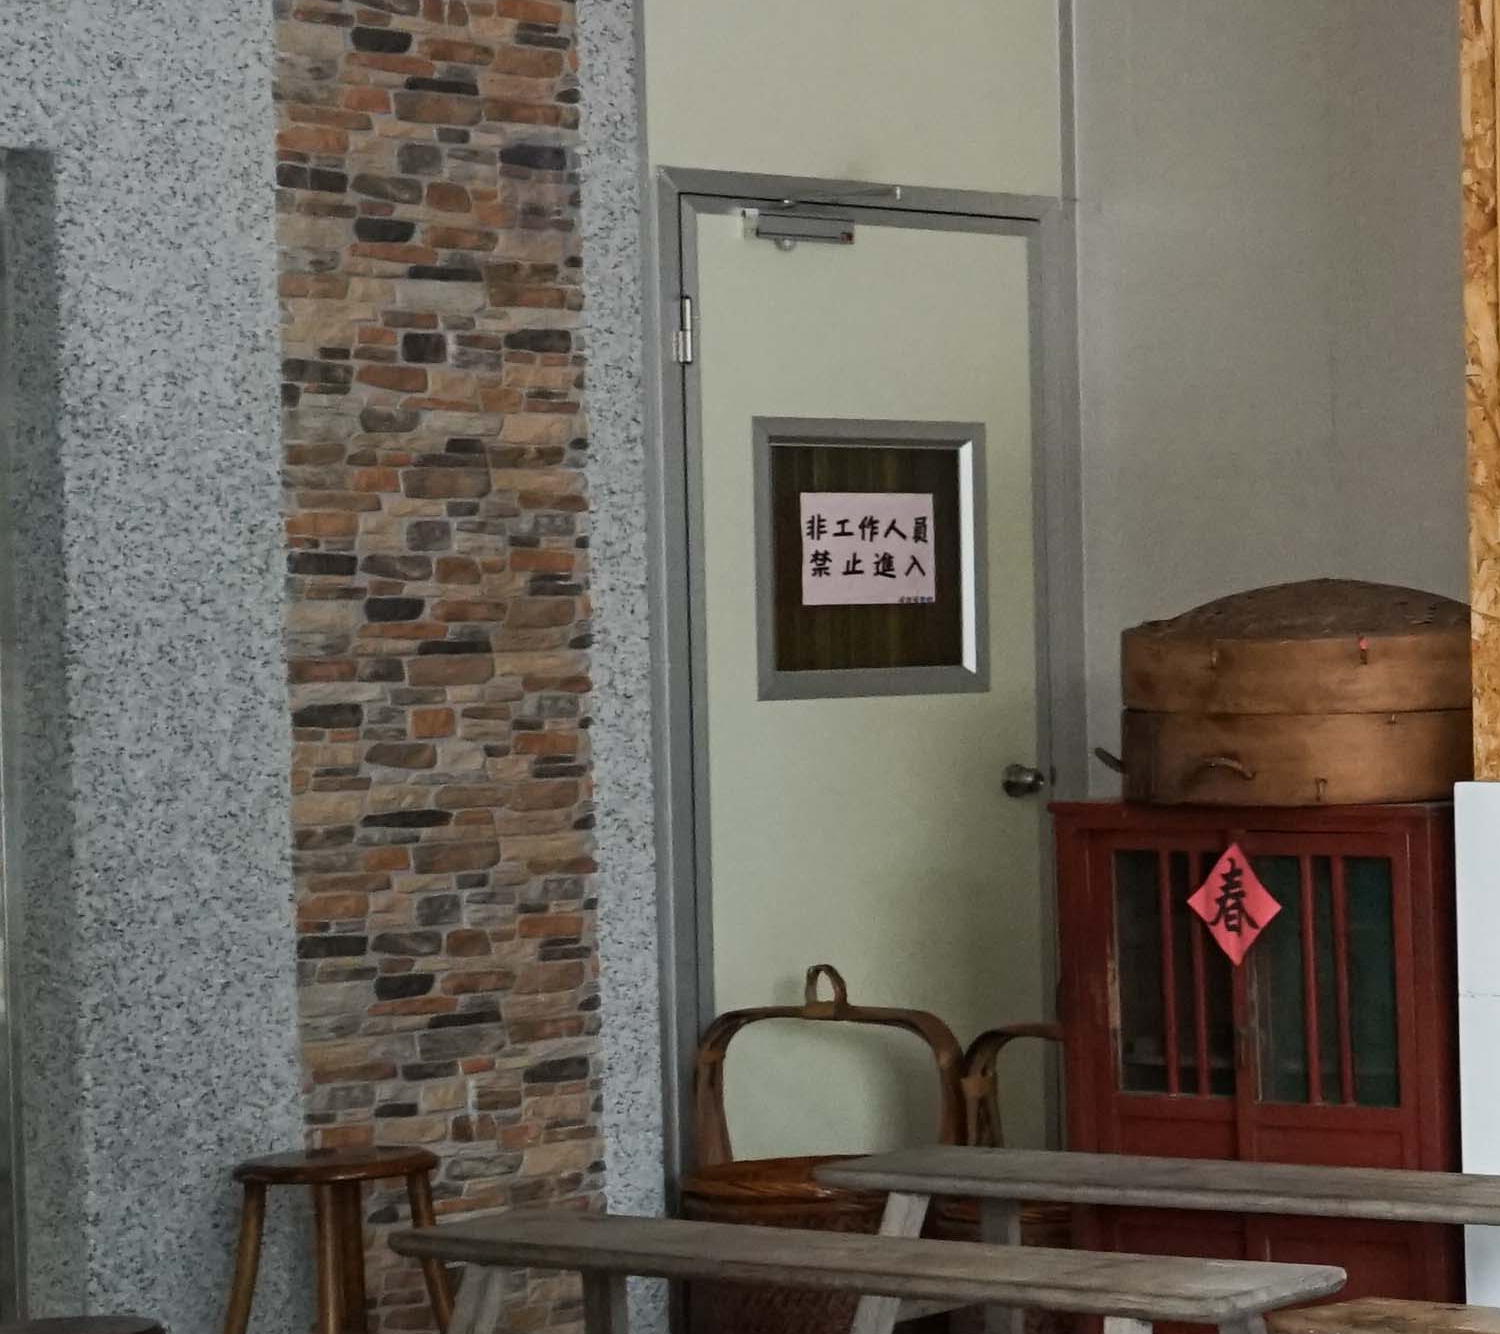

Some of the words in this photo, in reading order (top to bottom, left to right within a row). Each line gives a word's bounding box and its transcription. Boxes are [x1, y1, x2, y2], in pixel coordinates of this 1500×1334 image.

[805, 513, 930, 544] 非工作人員
[810, 551, 926, 579] 禁止進入
[1208, 856, 1261, 934] 春
